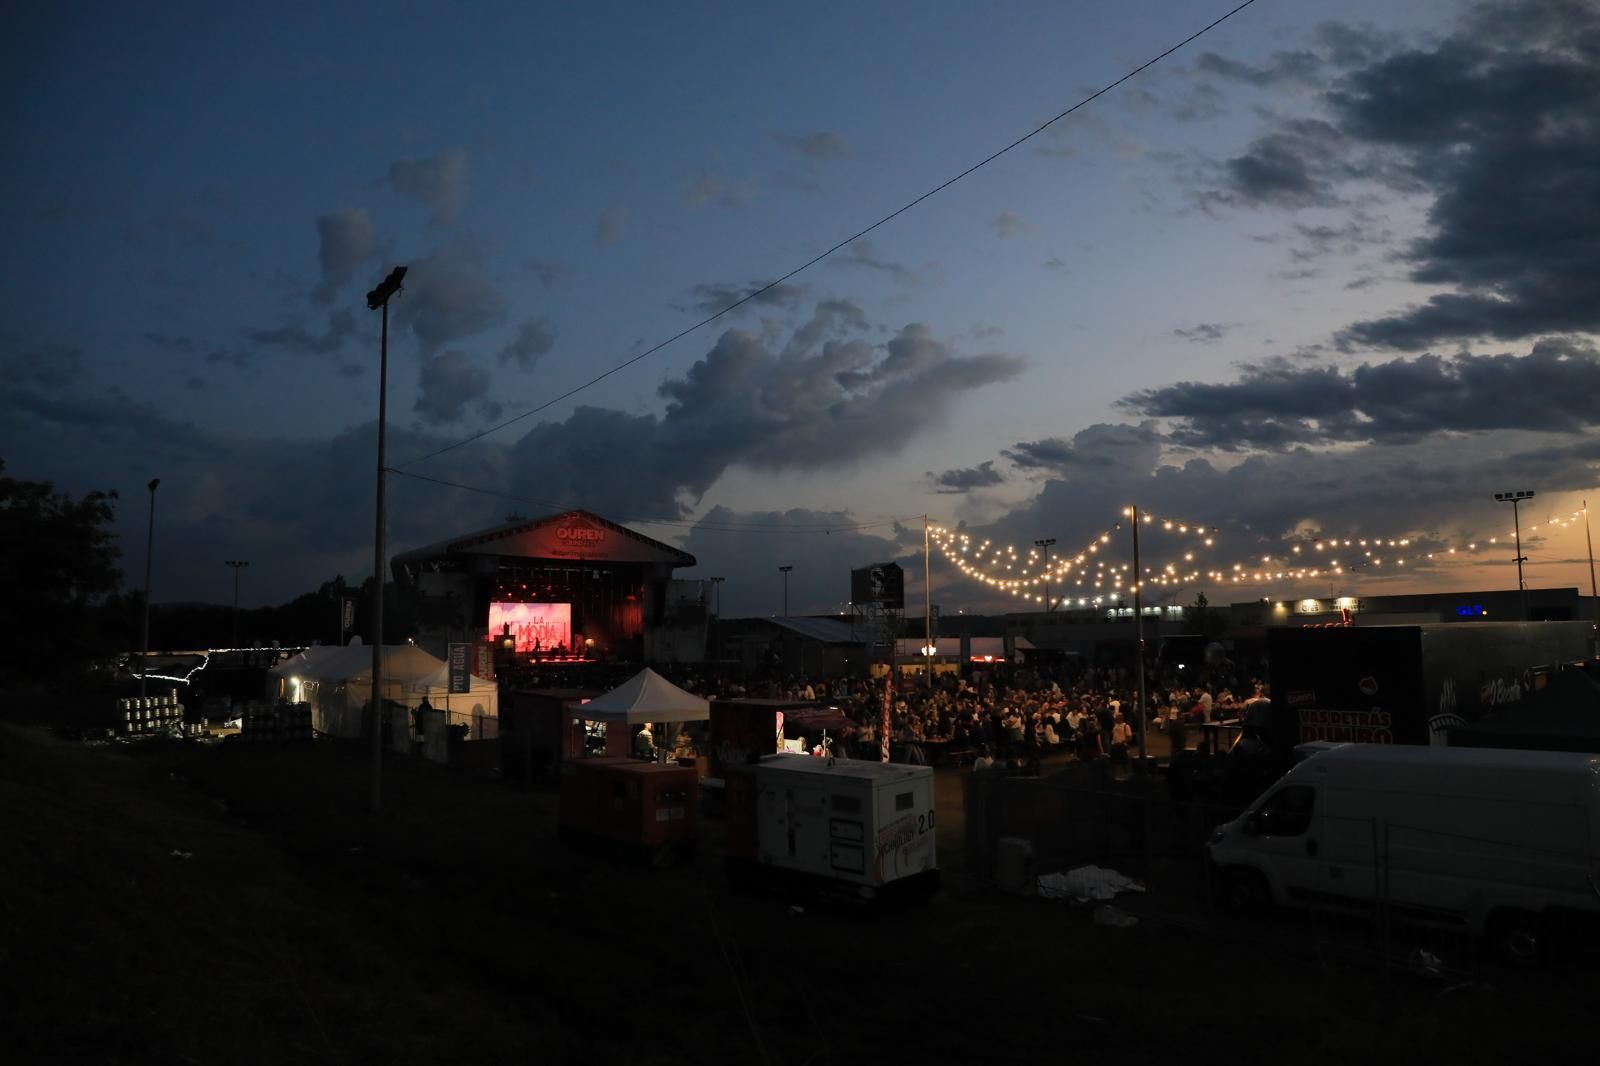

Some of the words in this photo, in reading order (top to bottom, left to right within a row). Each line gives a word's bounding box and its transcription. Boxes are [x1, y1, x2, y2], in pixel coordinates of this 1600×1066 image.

[556, 527, 605, 540] OUREN
[533, 616, 544, 624] LA
[453, 647, 465, 671] AGUA
[1298, 709, 1327, 723] VAS
[917, 809, 934, 835] 2.0
